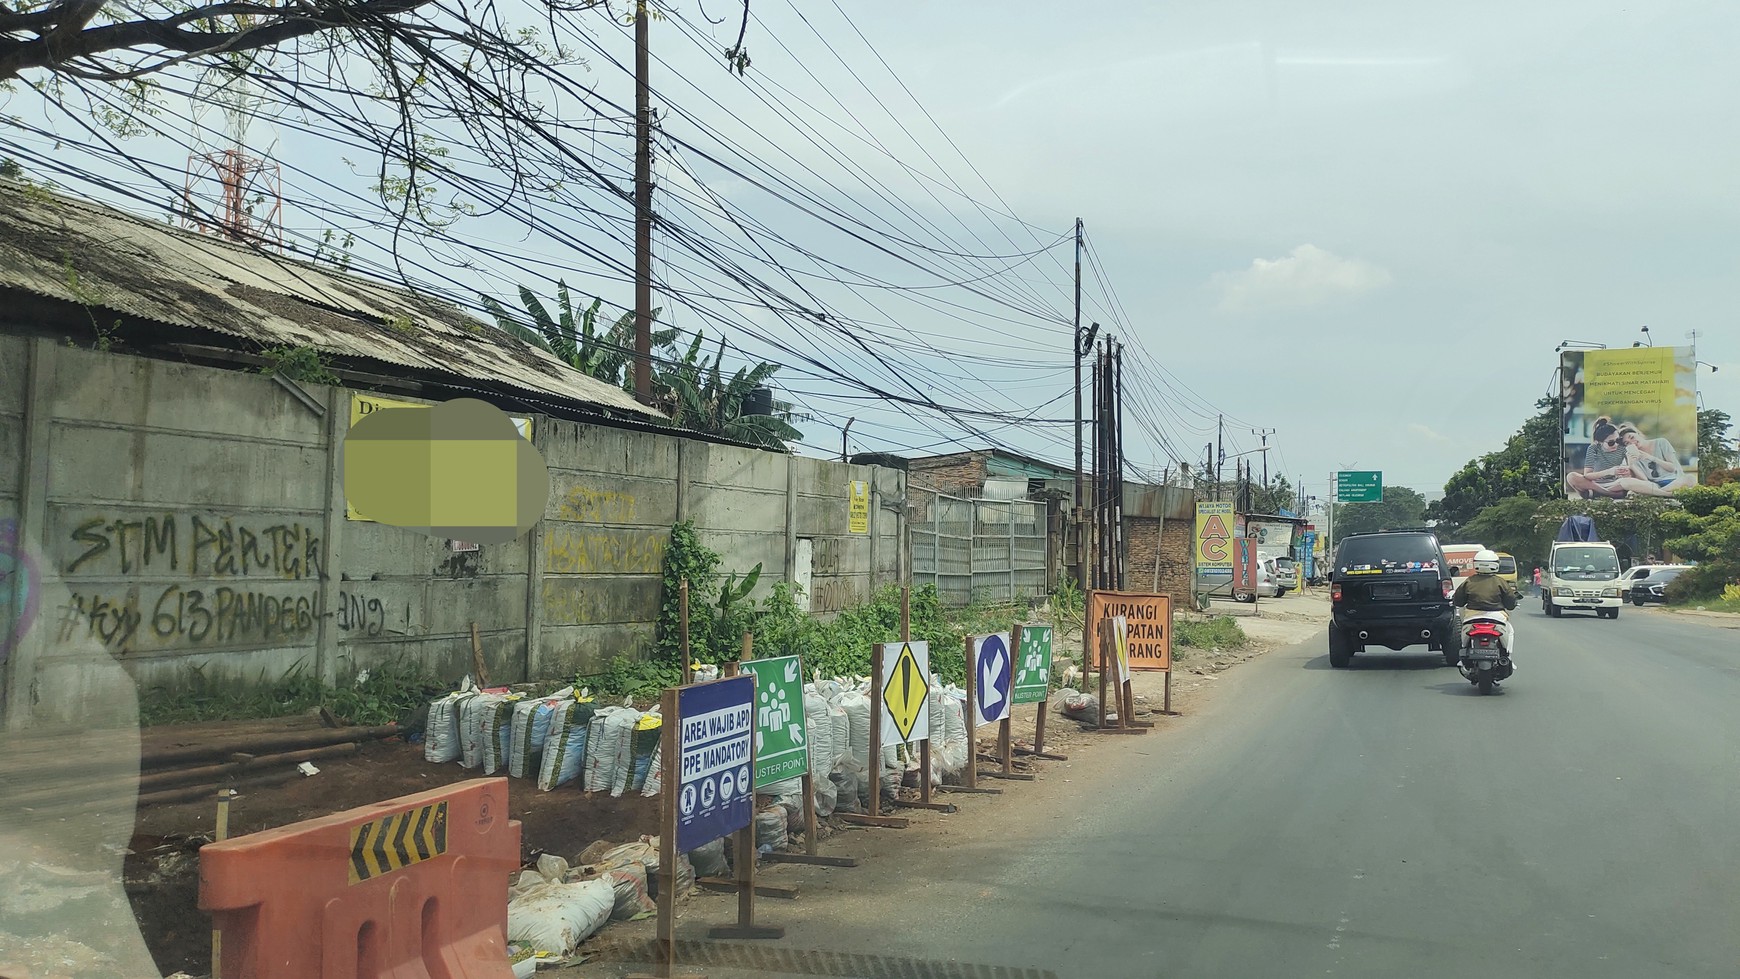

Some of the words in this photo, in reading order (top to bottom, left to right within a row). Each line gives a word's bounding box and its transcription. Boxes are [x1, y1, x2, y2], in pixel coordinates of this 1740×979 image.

[67, 514, 177, 574] STM
[1103, 603, 1157, 620] KURANGI
[684, 722, 707, 744] AREA
[708, 713, 734, 737] WAJIB
[736, 708, 750, 729] APD
[684, 753, 701, 777] PPE
[703, 738, 750, 770] MANDATORY
[755, 763, 781, 779] USTER
[783, 757, 805, 772] POINT
